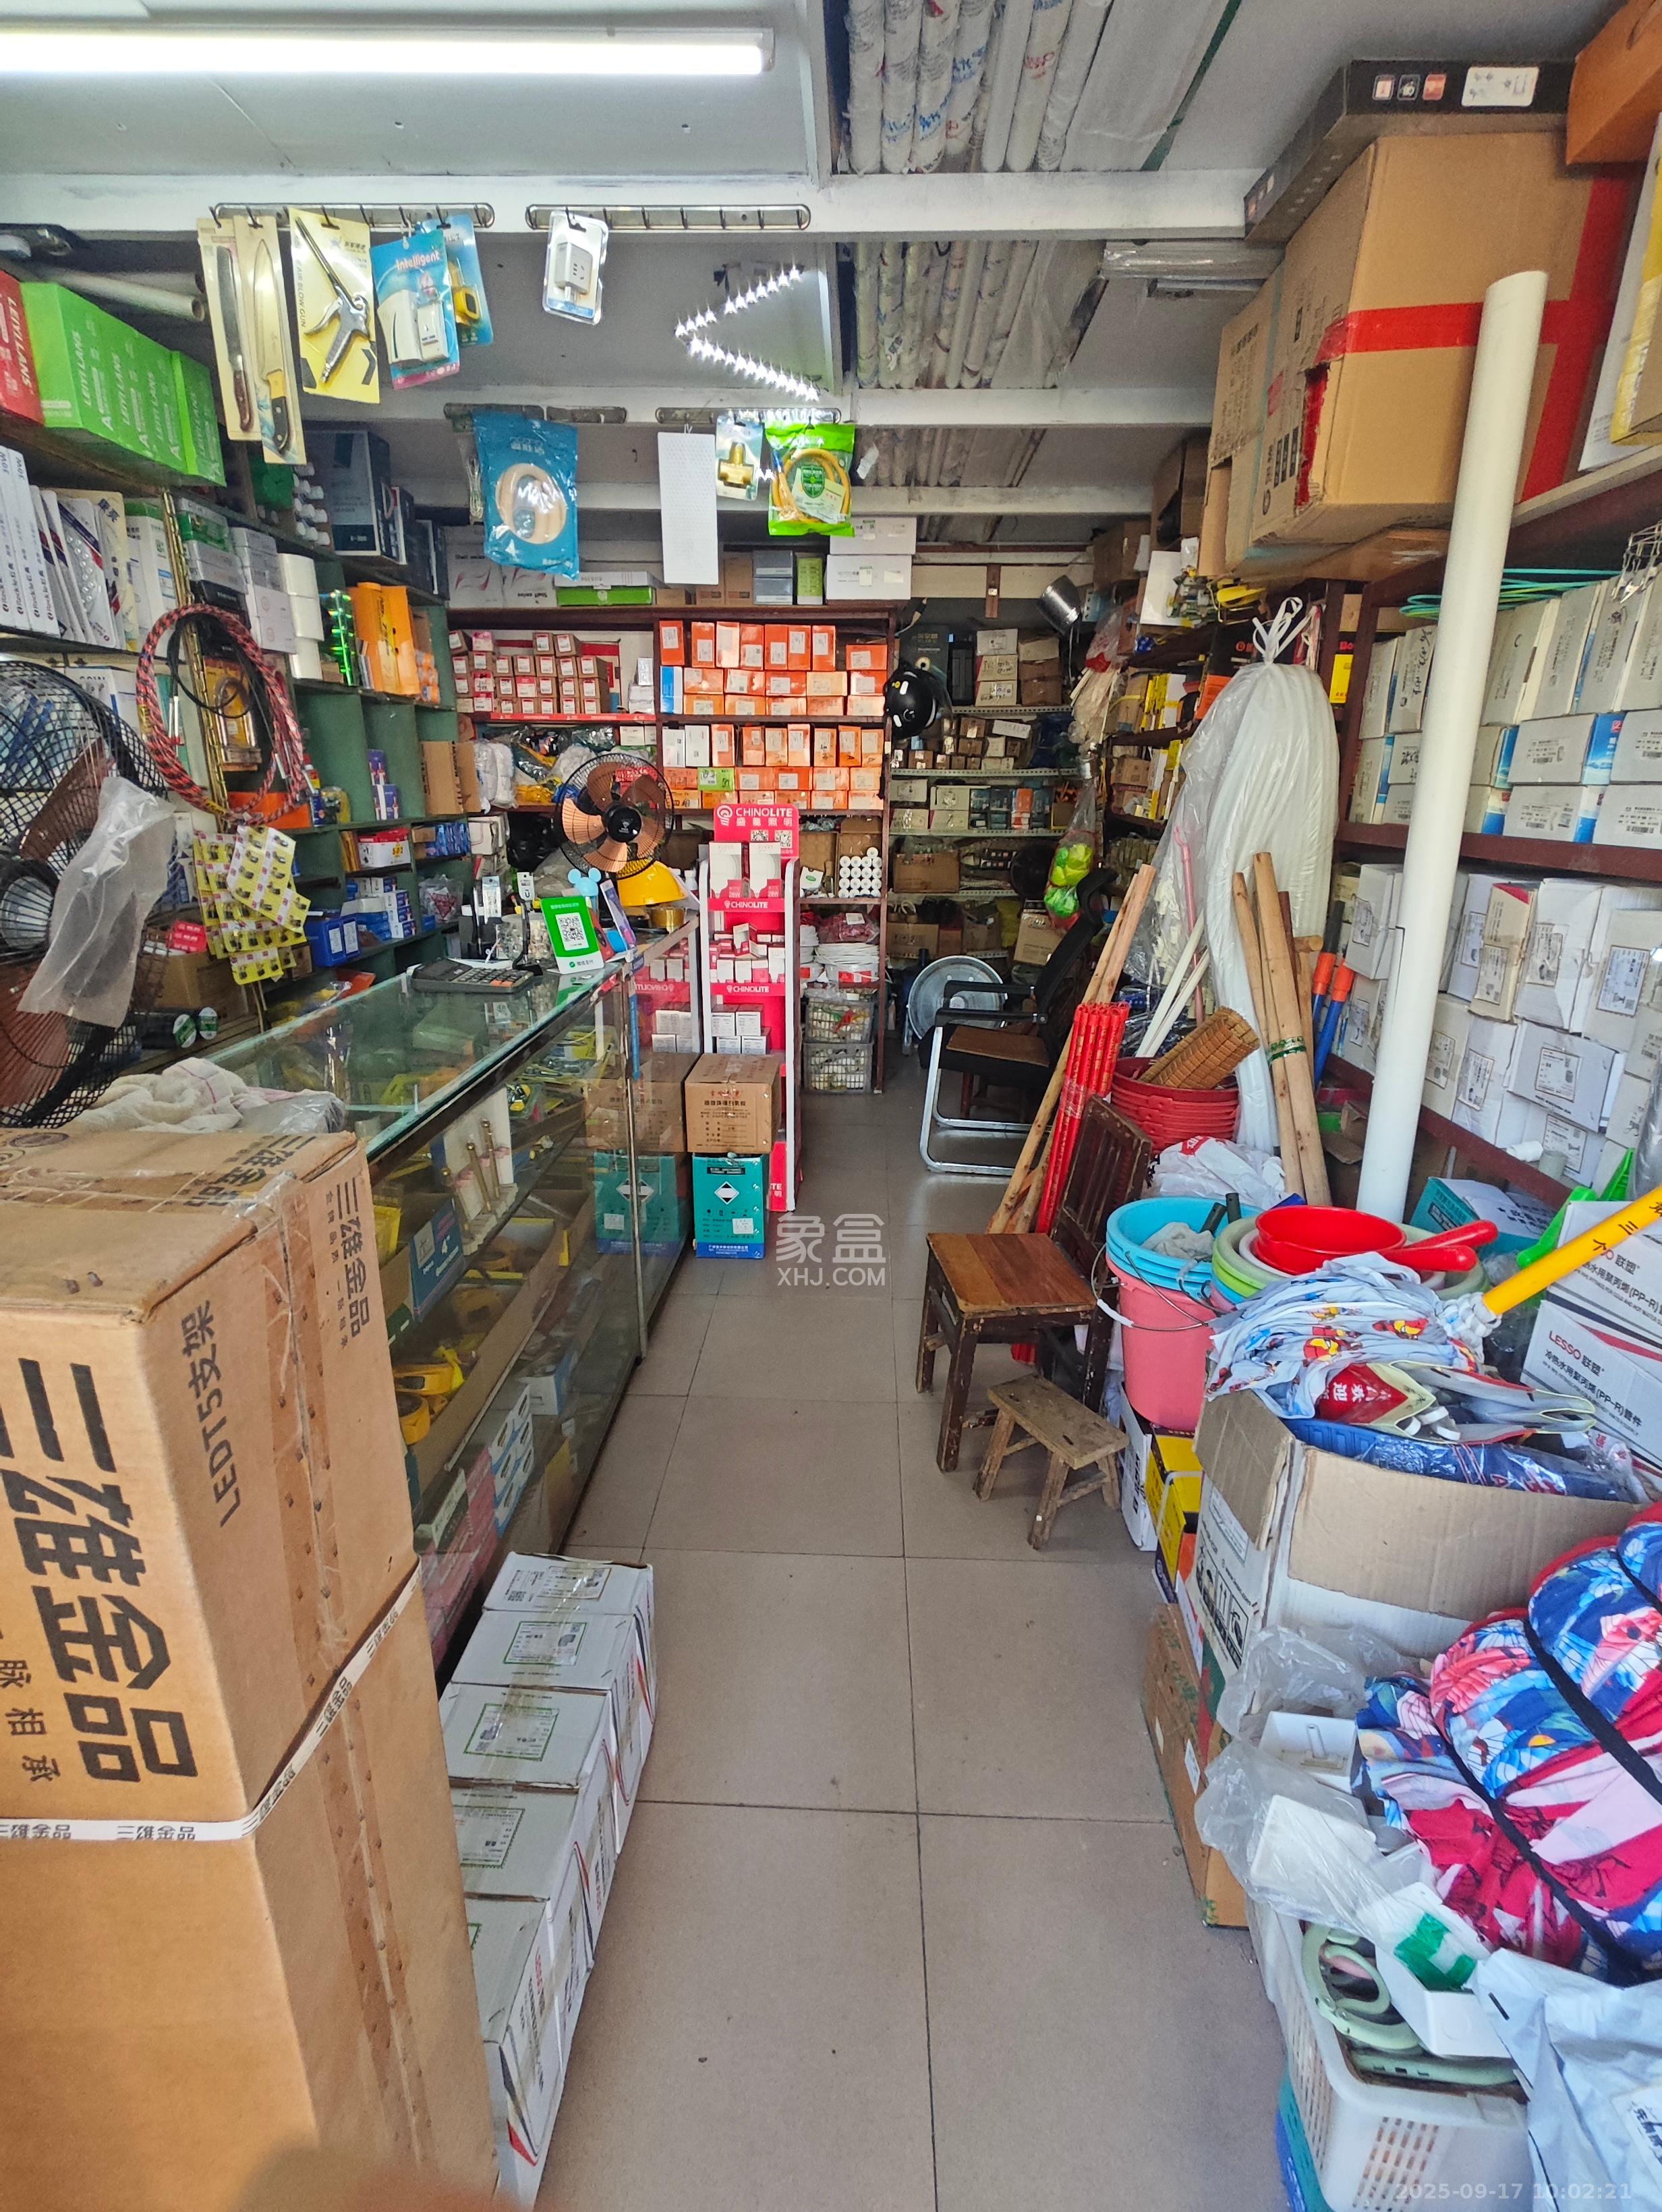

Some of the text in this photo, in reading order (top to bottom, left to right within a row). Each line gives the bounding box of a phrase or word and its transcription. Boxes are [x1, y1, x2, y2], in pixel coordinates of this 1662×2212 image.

[396, 250, 440, 270] Intelligent
[296, 283, 306, 307] BLOW
[299, 308, 308, 328] GUN
[735, 807, 793, 817] CHINOLITE
[336, 1177, 370, 1338] 三雄金品
[1549, 1330, 1582, 1360] LESSO
[181, 1299, 241, 1529] LEDT5支架
[0, 1357, 198, 1784] 三雄金品
[316, 1676, 353, 1738] 三雄金品
[117, 1825, 196, 1840] 三雄金品
